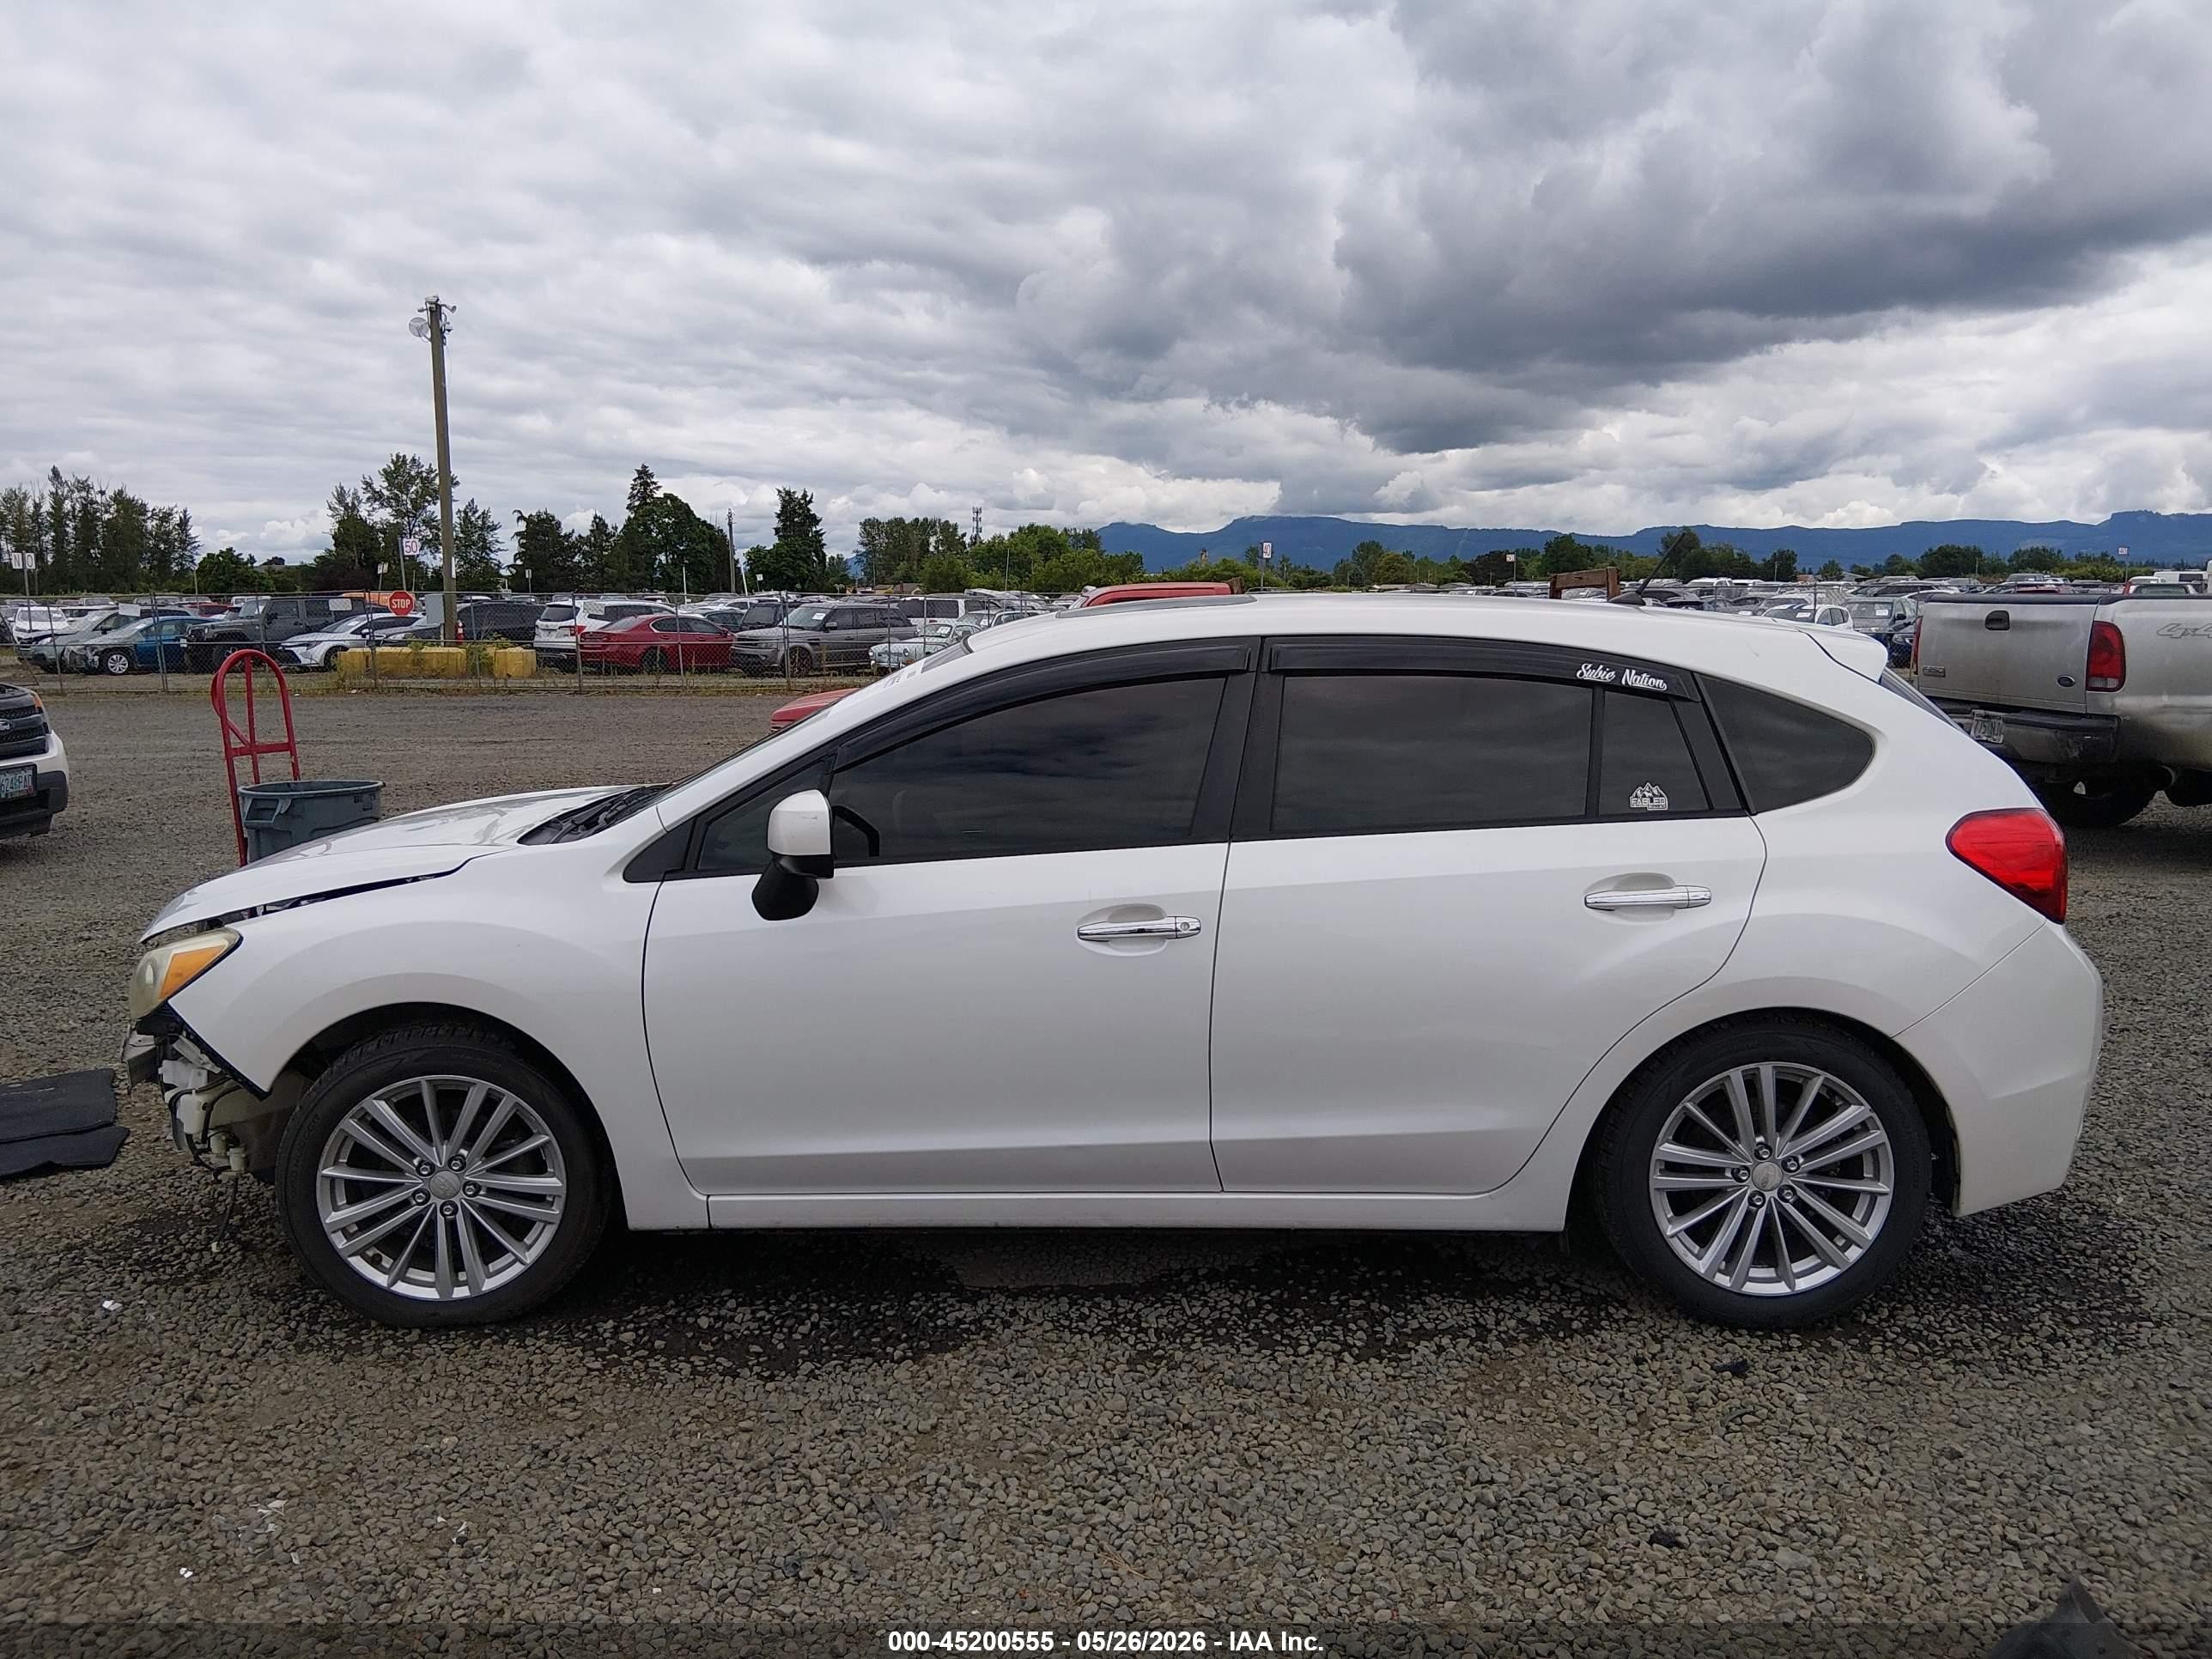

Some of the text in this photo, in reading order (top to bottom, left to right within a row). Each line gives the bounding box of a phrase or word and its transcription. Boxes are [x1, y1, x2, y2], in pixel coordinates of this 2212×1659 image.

[404, 540, 418, 554] 50
[1263, 543, 1271, 556] 40
[392, 599, 410, 609] STOP
[1576, 663, 1667, 691] Subie Nation
